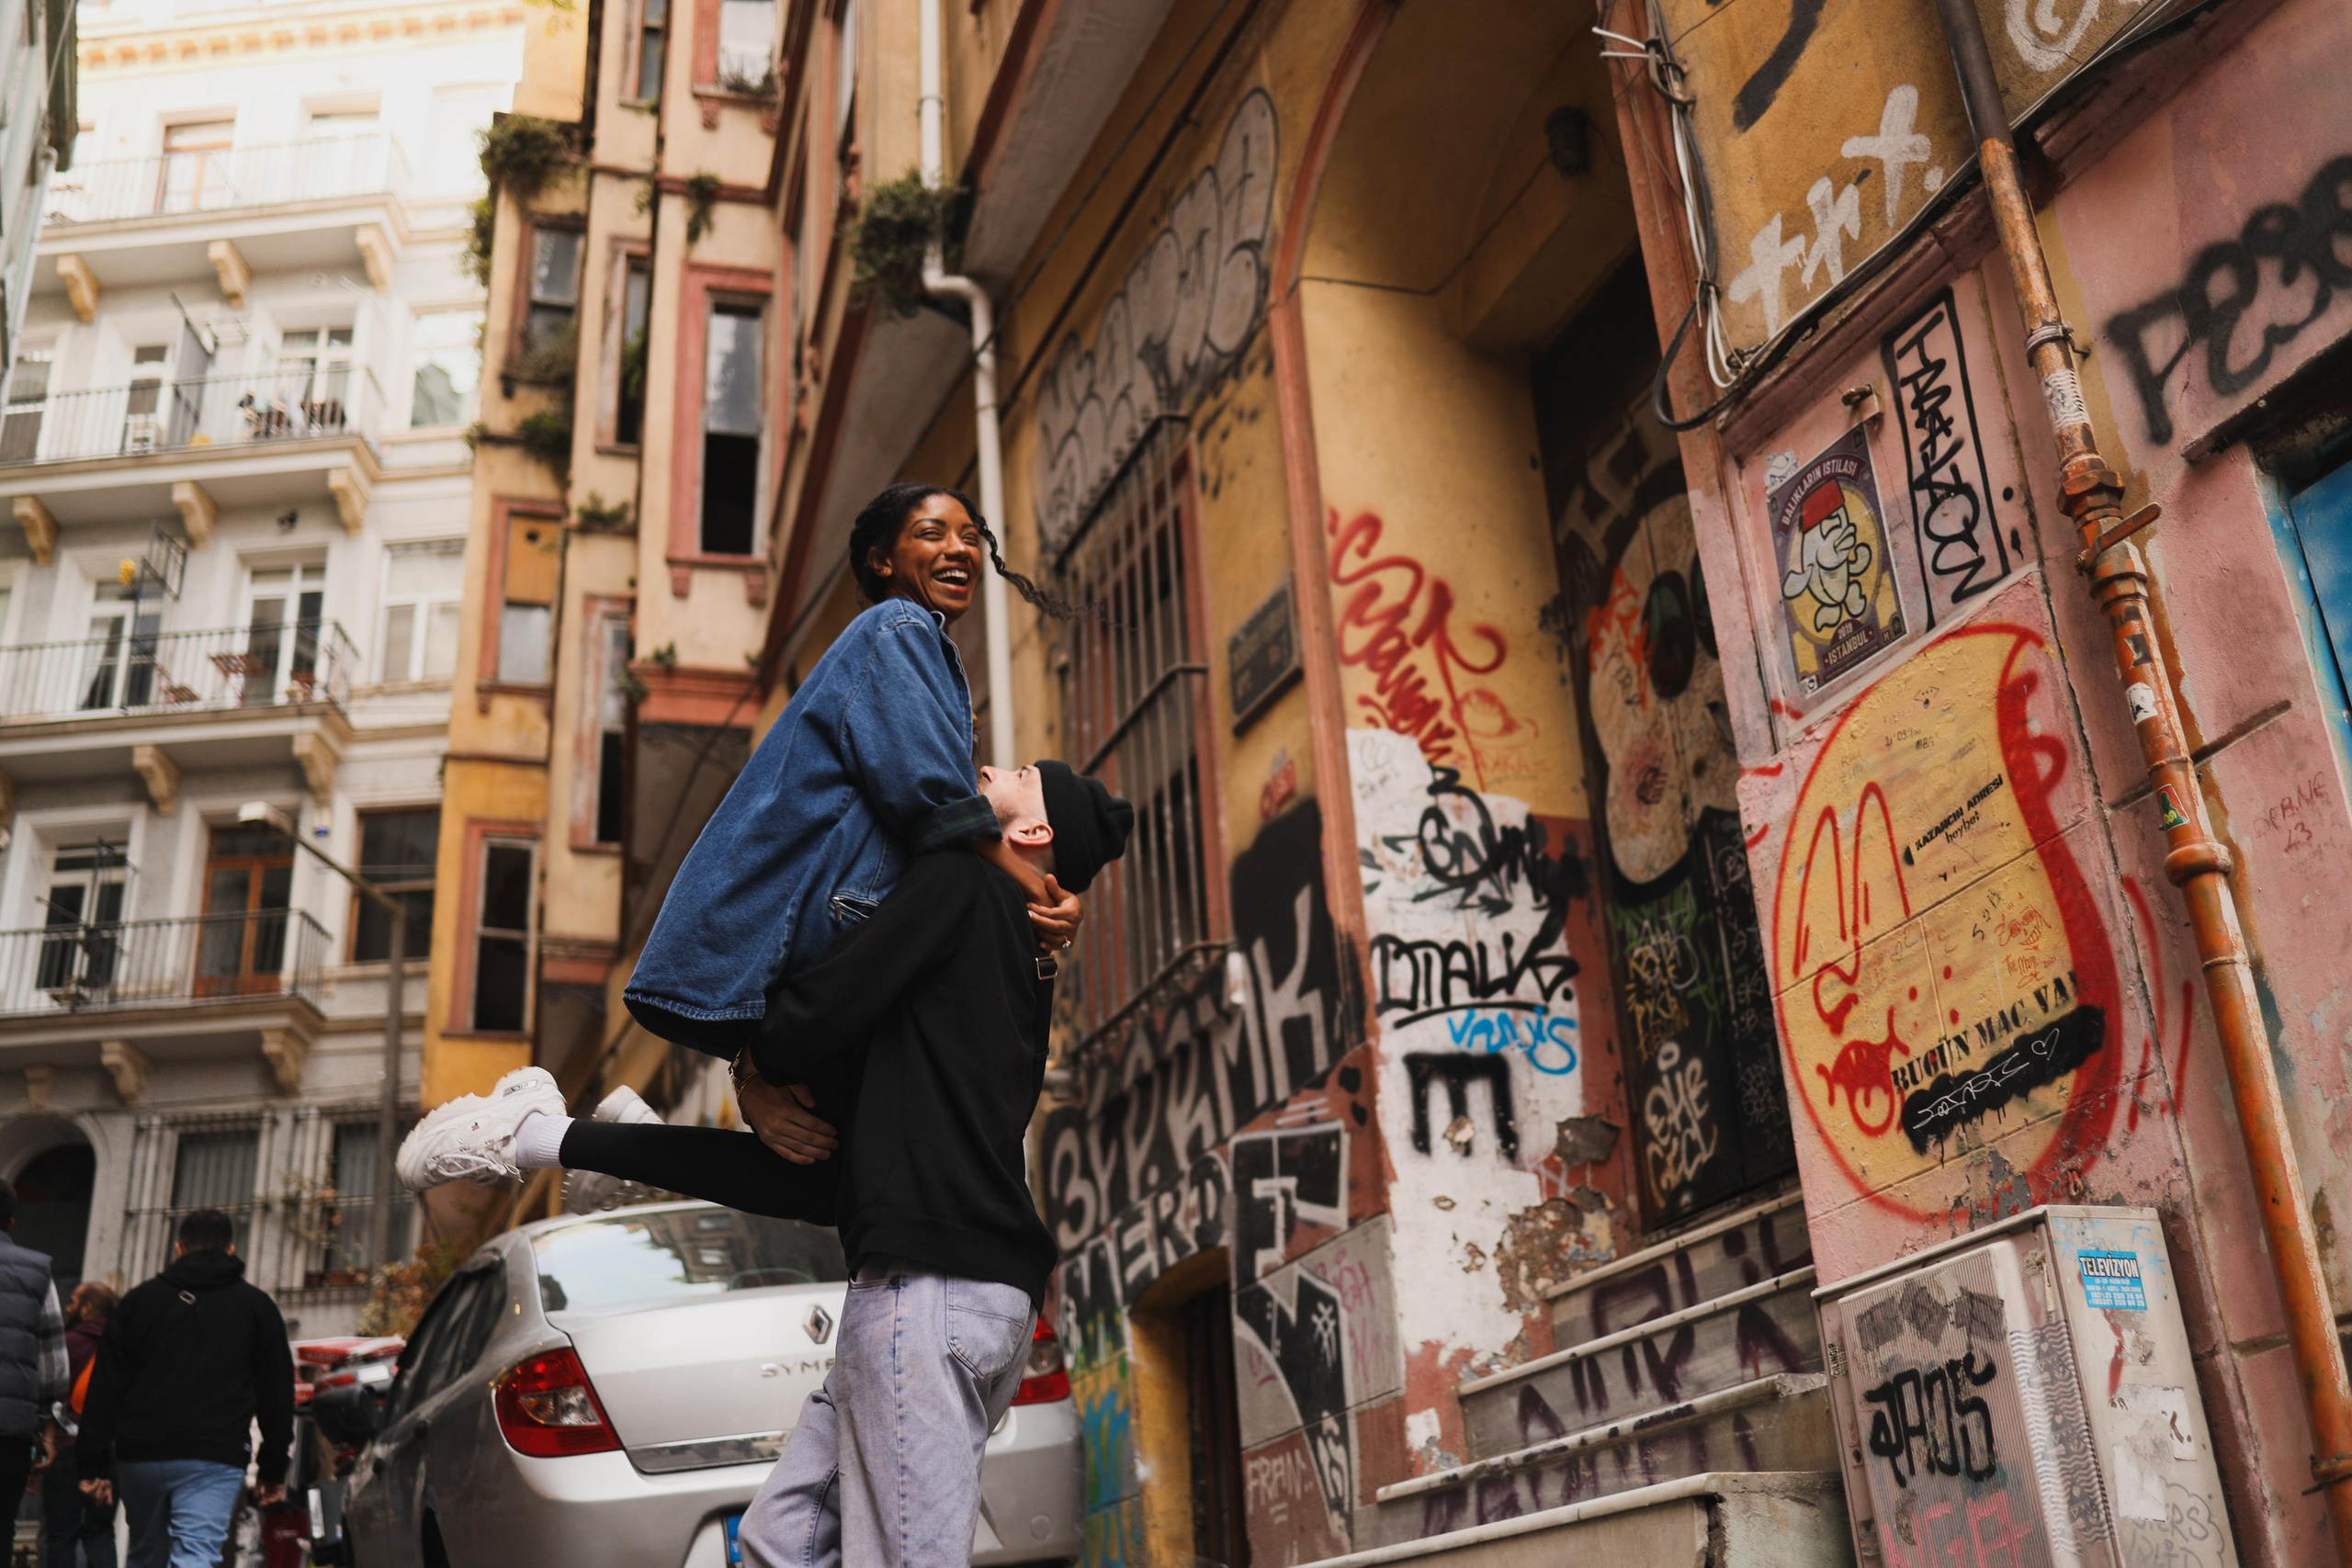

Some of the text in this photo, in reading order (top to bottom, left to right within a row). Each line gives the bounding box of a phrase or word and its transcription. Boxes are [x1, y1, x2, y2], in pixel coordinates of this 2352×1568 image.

[1781, 466, 1822, 525] BALIKLARIN
[1838, 622, 1853, 639] 2019
[1915, 807, 1963, 851] KAZANCIN
[2079, 1253, 2140, 1279] TELEVİZYON
